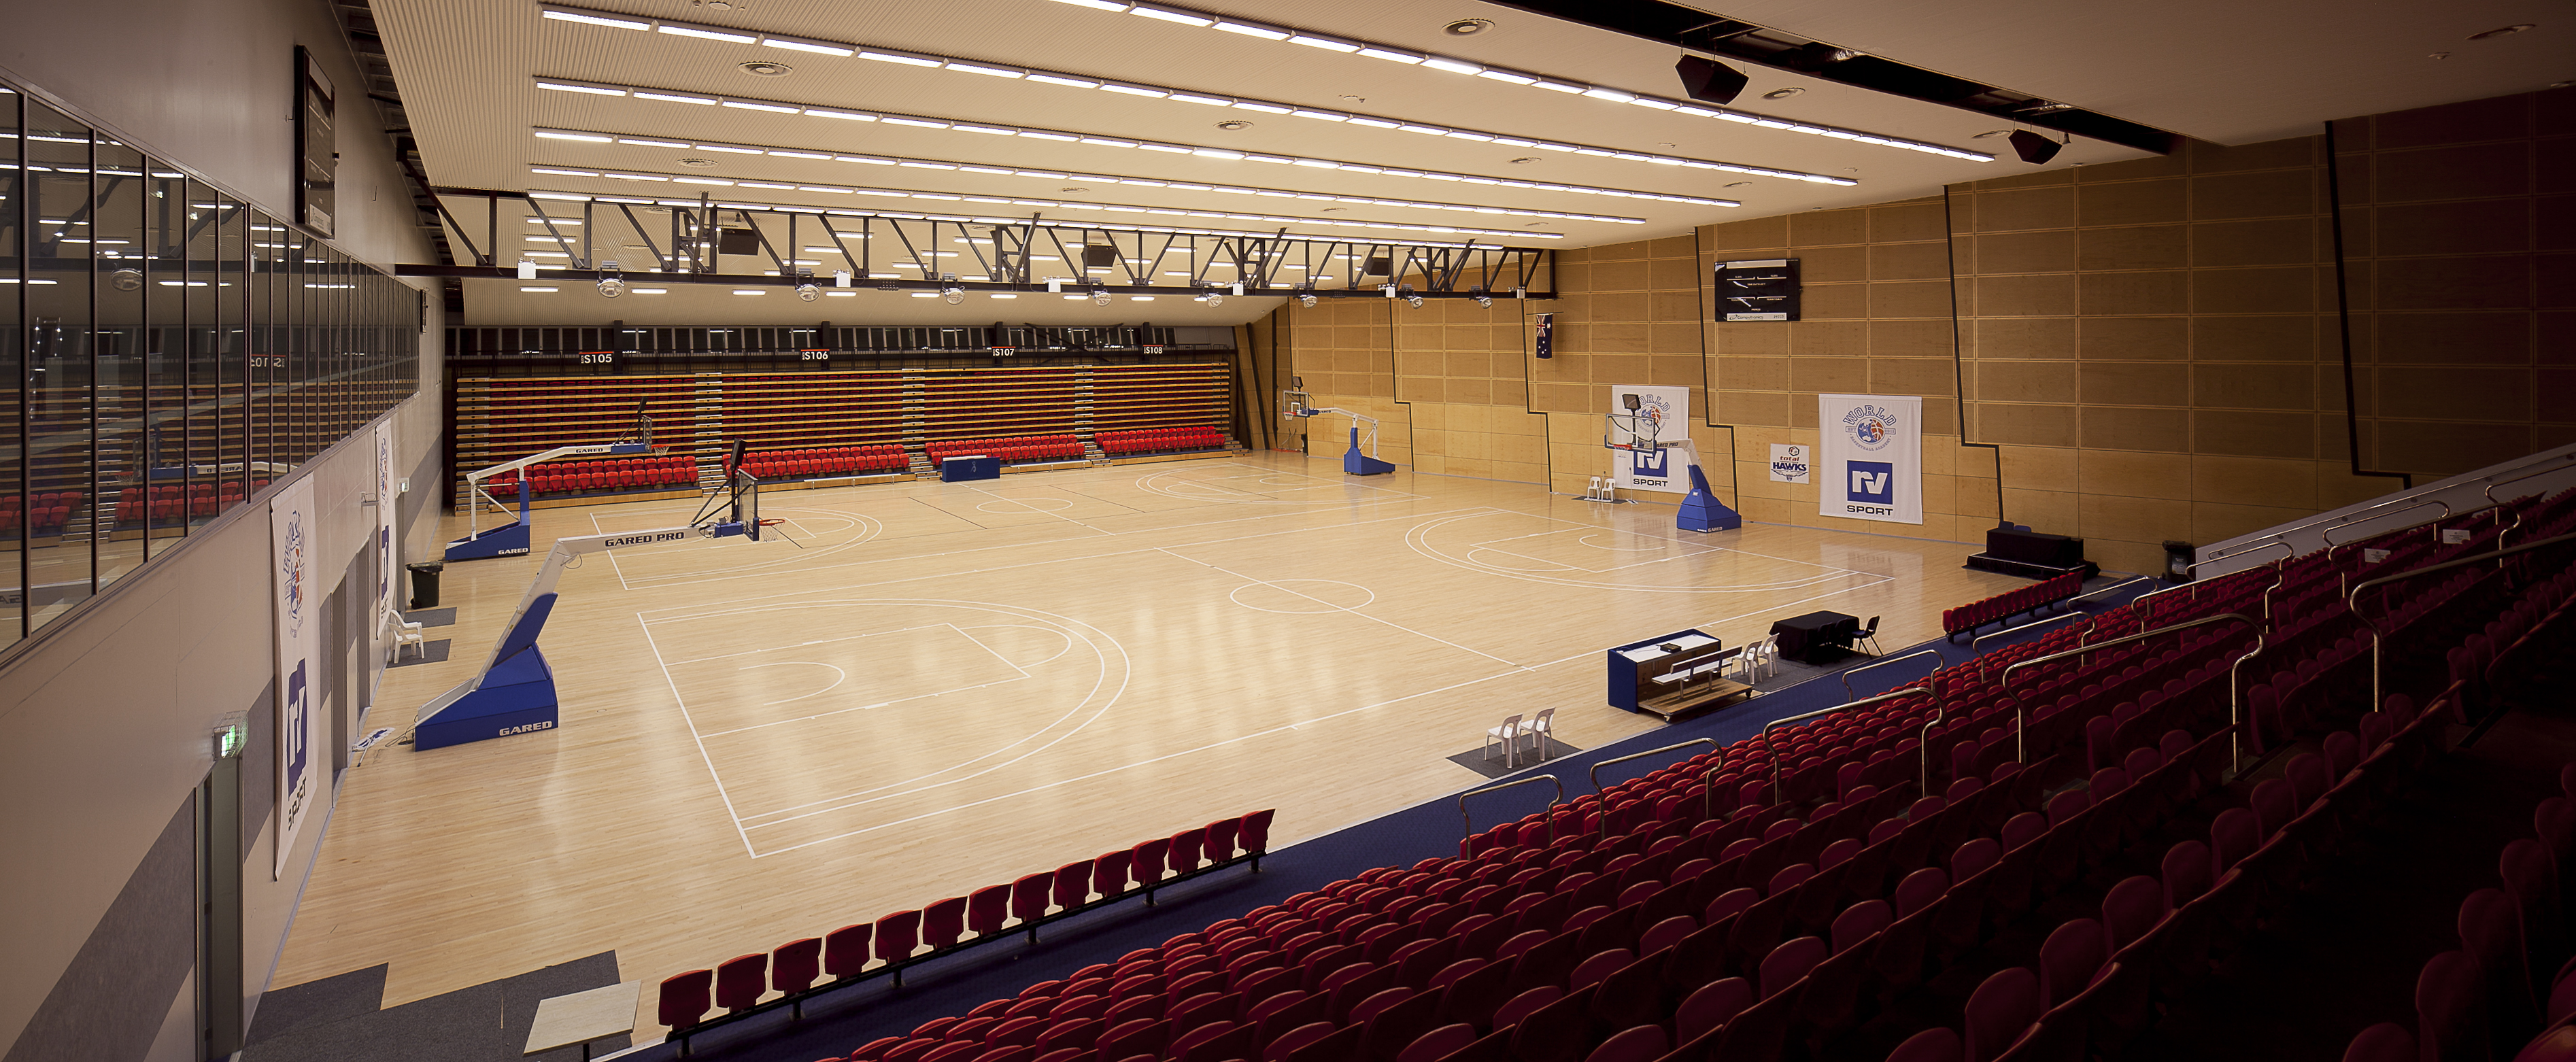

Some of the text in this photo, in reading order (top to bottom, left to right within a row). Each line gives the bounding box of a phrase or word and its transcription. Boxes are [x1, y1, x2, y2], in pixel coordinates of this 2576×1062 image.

[804, 351, 828, 360] S106
[995, 348, 1015, 356] S107
[584, 354, 612, 364] S105
[1638, 394, 1670, 412] ORLD
[1842, 405, 1897, 426] WORLD
[1850, 436, 1874, 451] BASKETBALL
[1772, 462, 1807, 472] HAWKS
[1633, 478, 1668, 487] SPORT
[1847, 504, 1893, 516] SPORT
[605, 532, 684, 547] GARED PRO
[499, 721, 552, 736] GARED
